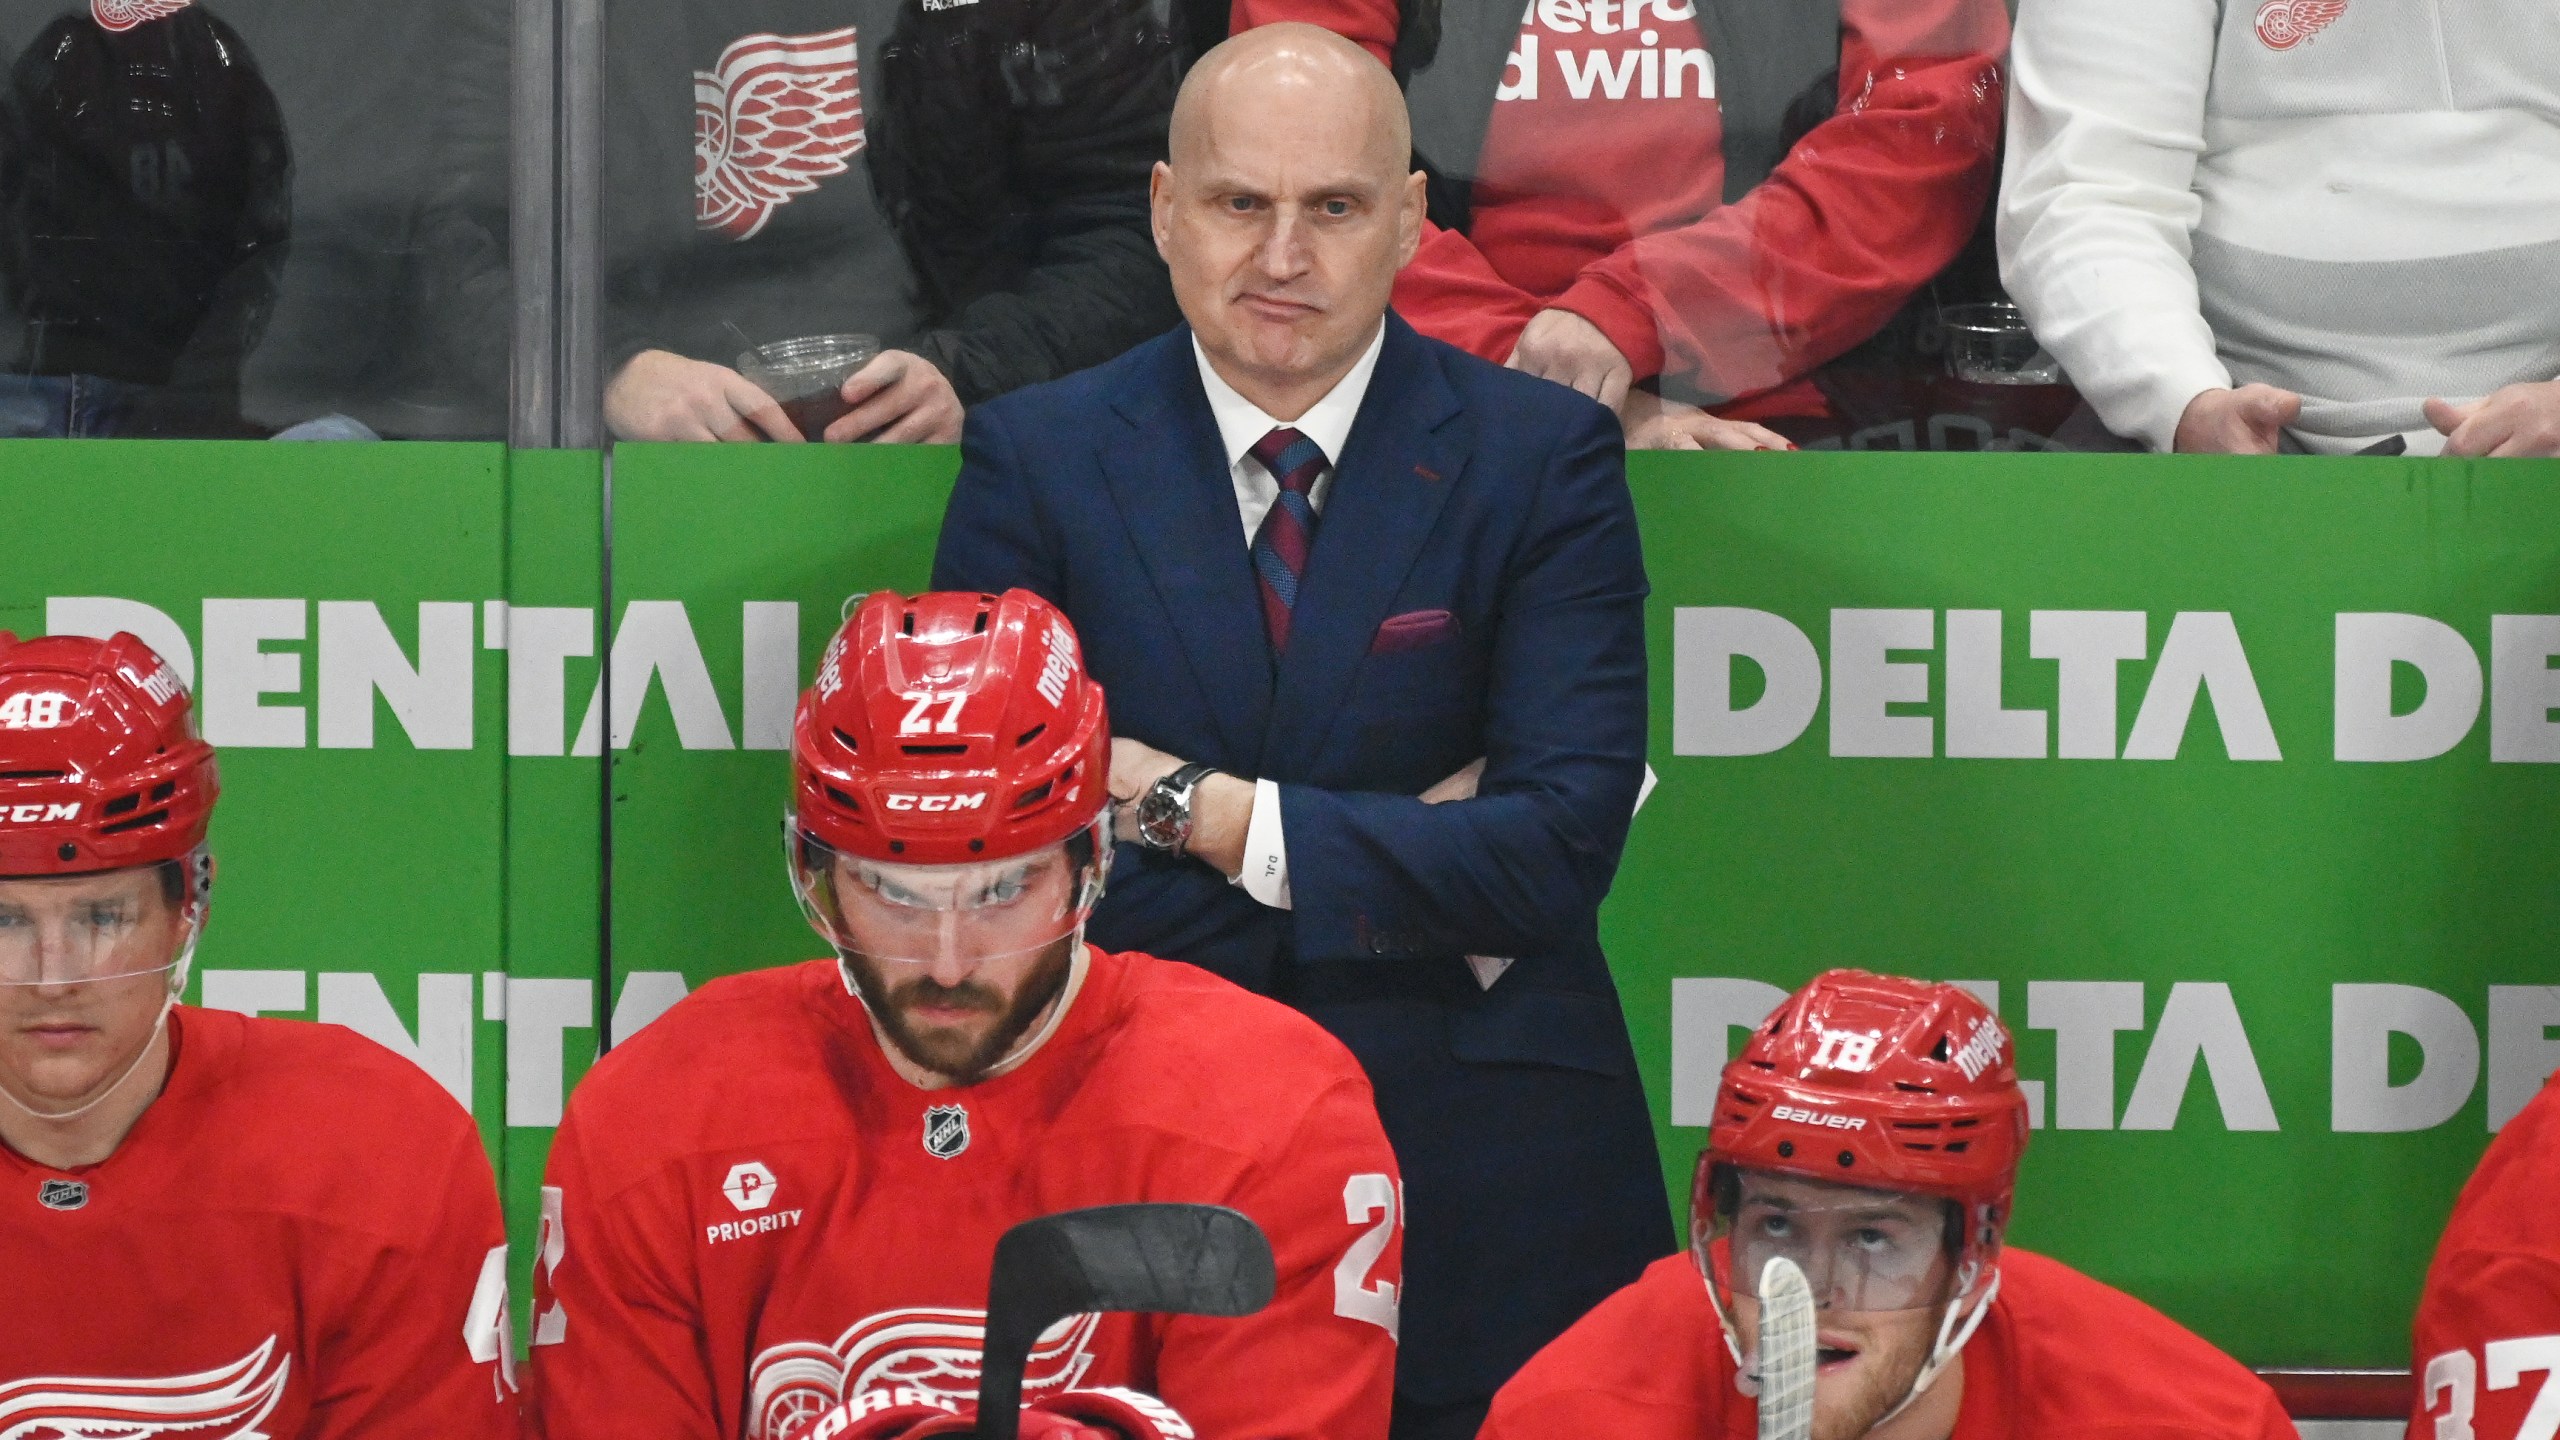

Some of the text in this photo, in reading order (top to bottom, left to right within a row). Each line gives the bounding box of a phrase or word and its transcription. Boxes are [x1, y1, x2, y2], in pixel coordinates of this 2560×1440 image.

[1522, 0, 1698, 35] etro
[1673, 606, 2560, 763] DELTA DE
[0, 692, 64, 728] 48
[900, 691, 967, 733] 27
[0, 802, 81, 822] CM
[886, 792, 987, 812] CCM
[1671, 977, 2280, 1131] DTA
[706, 1208, 804, 1246] PRIORITY
[1334, 1173, 1404, 1342] 2
[2424, 1335, 2560, 1440] 37
